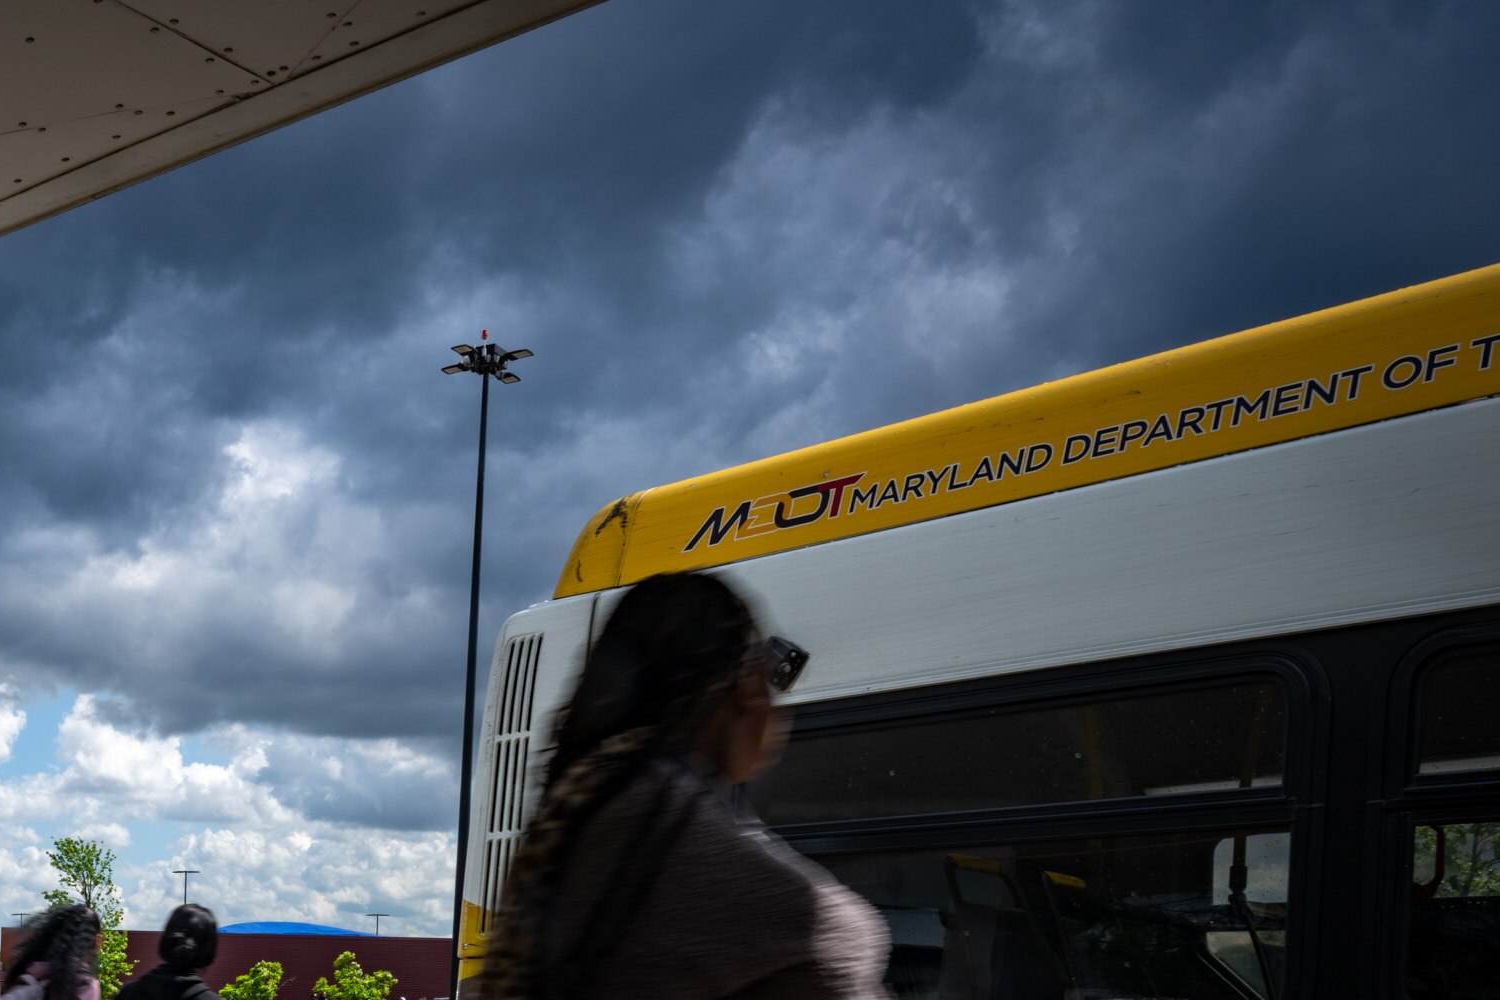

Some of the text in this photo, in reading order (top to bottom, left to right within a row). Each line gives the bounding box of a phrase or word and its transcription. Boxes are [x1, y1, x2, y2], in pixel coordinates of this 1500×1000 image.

[848, 443, 1054, 515] MARYLAND
[1061, 363, 1375, 466] DEPARTMENT
[1381, 343, 1461, 391] OF
